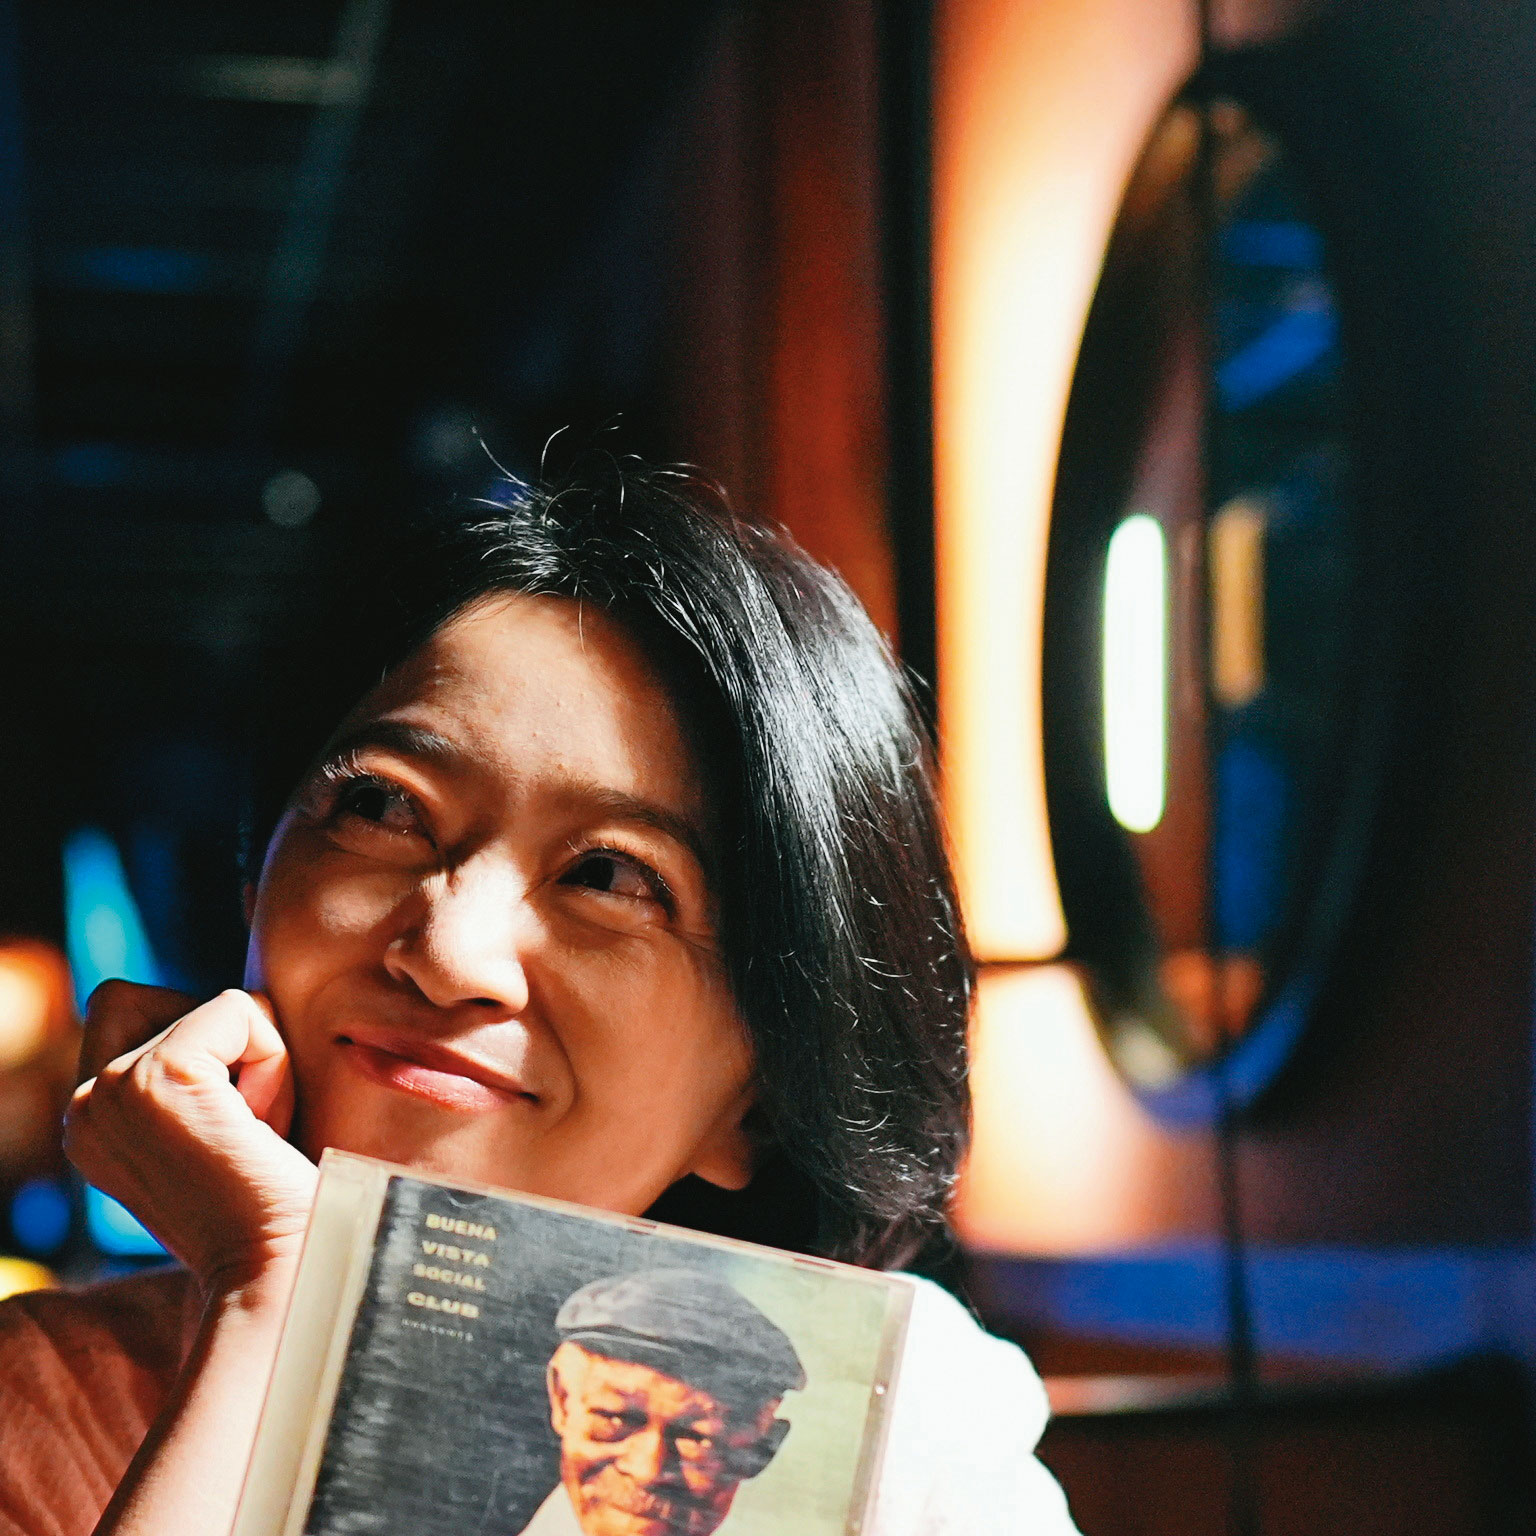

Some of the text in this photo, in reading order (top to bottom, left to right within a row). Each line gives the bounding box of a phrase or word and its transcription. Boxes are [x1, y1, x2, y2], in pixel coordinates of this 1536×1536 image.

[426, 1213, 497, 1241] BUENA
[422, 1240, 490, 1268] VISTA
[413, 1263, 486, 1291] SOCIAL
[407, 1291, 480, 1319] CLUB
